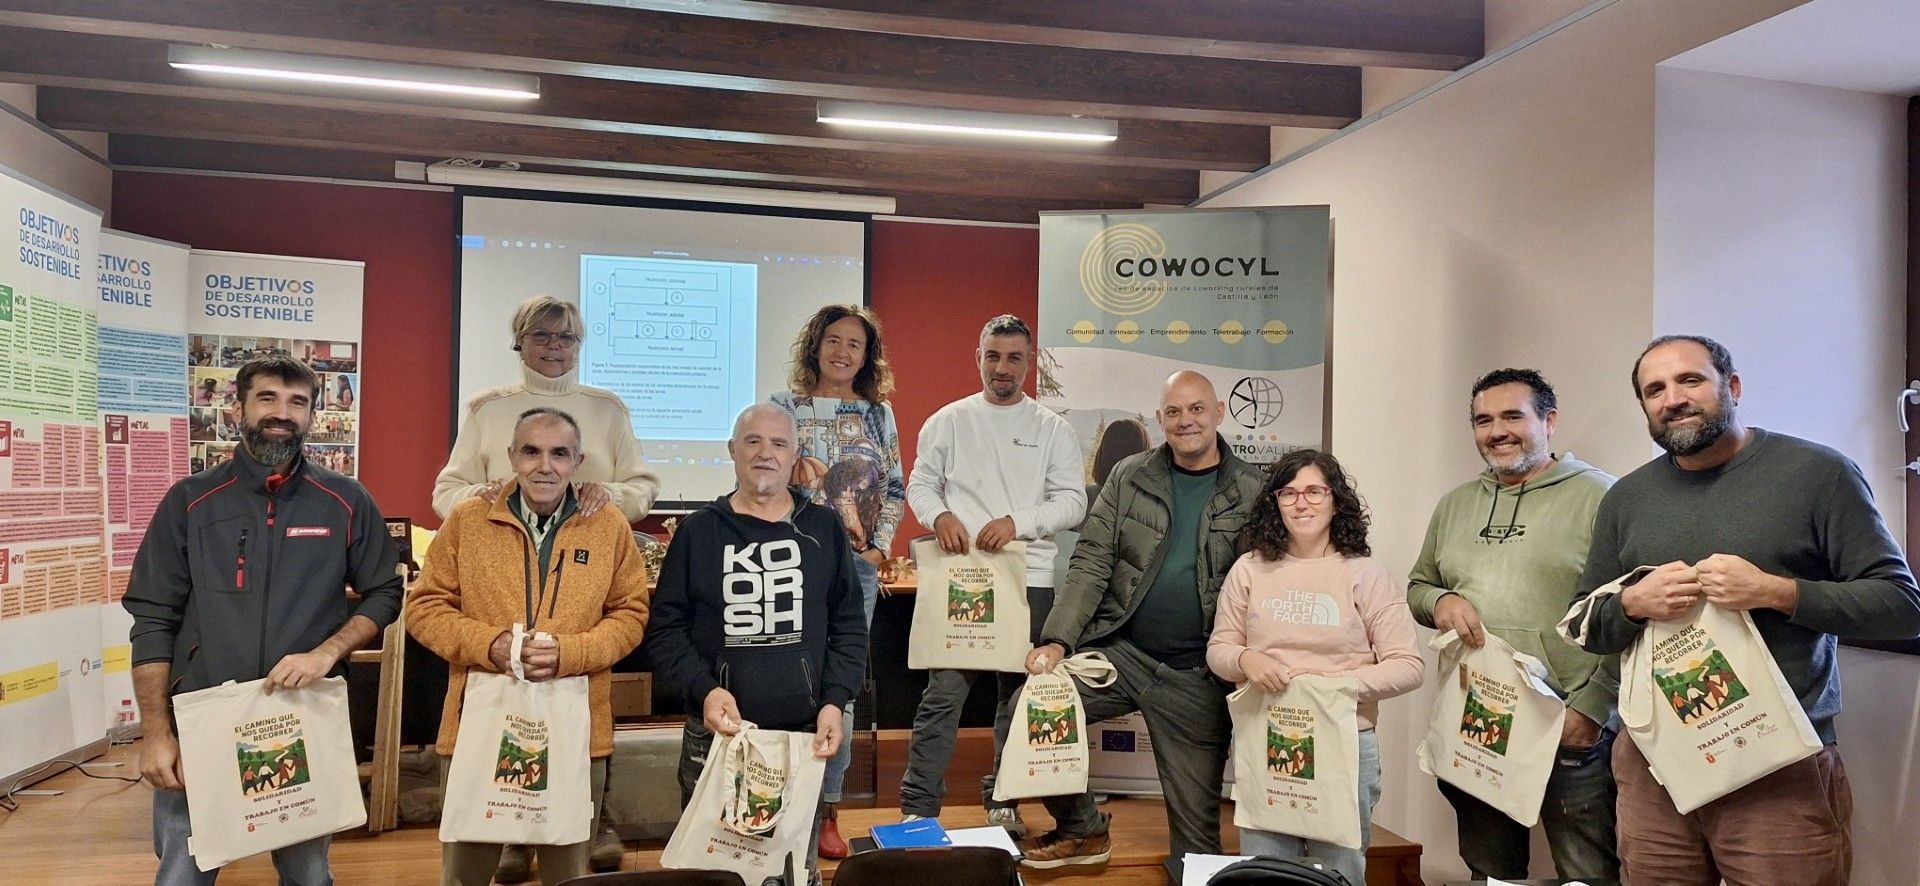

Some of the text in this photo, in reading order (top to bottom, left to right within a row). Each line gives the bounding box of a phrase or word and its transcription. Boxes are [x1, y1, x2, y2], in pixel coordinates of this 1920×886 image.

[20, 207, 79, 245] OBJETIVOS
[20, 229, 80, 260] DE DESARROLLO
[20, 246, 81, 280] SOSTENIBLE
[1115, 257, 1280, 278] COWOCYL
[205, 274, 315, 295] OBJETIVOS
[1193, 284, 1234, 292] coworking
[205, 290, 314, 307] DE DESARROLLO
[1259, 292, 1279, 300] León
[204, 303, 314, 322] SOSTENIBLE
[1109, 327, 1145, 336] Innovación
[1150, 328, 1207, 337] Emprendimiento
[1212, 328, 1251, 337] Teletrabajo
[1256, 327, 1294, 336] Formación
[1286, 590, 1315, 603] THE
[1261, 598, 1313, 613] NORTH
[1273, 610, 1310, 624] FACE
[1680, 624, 1696, 637] QUE
[1667, 638, 1690, 654] QUEDA
[1691, 629, 1706, 641] POR
[1665, 640, 1703, 664] RECORRER
[1475, 680, 1518, 700] NOS QUEDA POR
[1479, 674, 1501, 687] CAMINO
[1503, 683, 1516, 692] QUE
[1481, 689, 1510, 704] RECORRER
[245, 717, 277, 730] CAMINO
[279, 714, 294, 722] QUE
[515, 717, 535, 727] CAMINO
[1697, 703, 1744, 731] SOLIDARIDAD
[242, 719, 301, 738] NOS QUEDA POR
[511, 722, 522, 730] NOS
[1697, 732, 1730, 750] TRABAJO
[1730, 726, 1740, 735] EN
[1741, 712, 1768, 729] COMÚN
[253, 728, 293, 742] RECORRER
[750, 760, 771, 773] CAMINO
[751, 775, 779, 788] RECORRER
[758, 770, 774, 780] QUEDA
[253, 787, 302, 803] SOLIDARIDAD
[500, 788, 540, 797] SOLIDARIDAD
[245, 809, 278, 820] TRABAJO
[290, 798, 316, 809] COMÚN
[710, 838, 737, 848] TRABAJO
